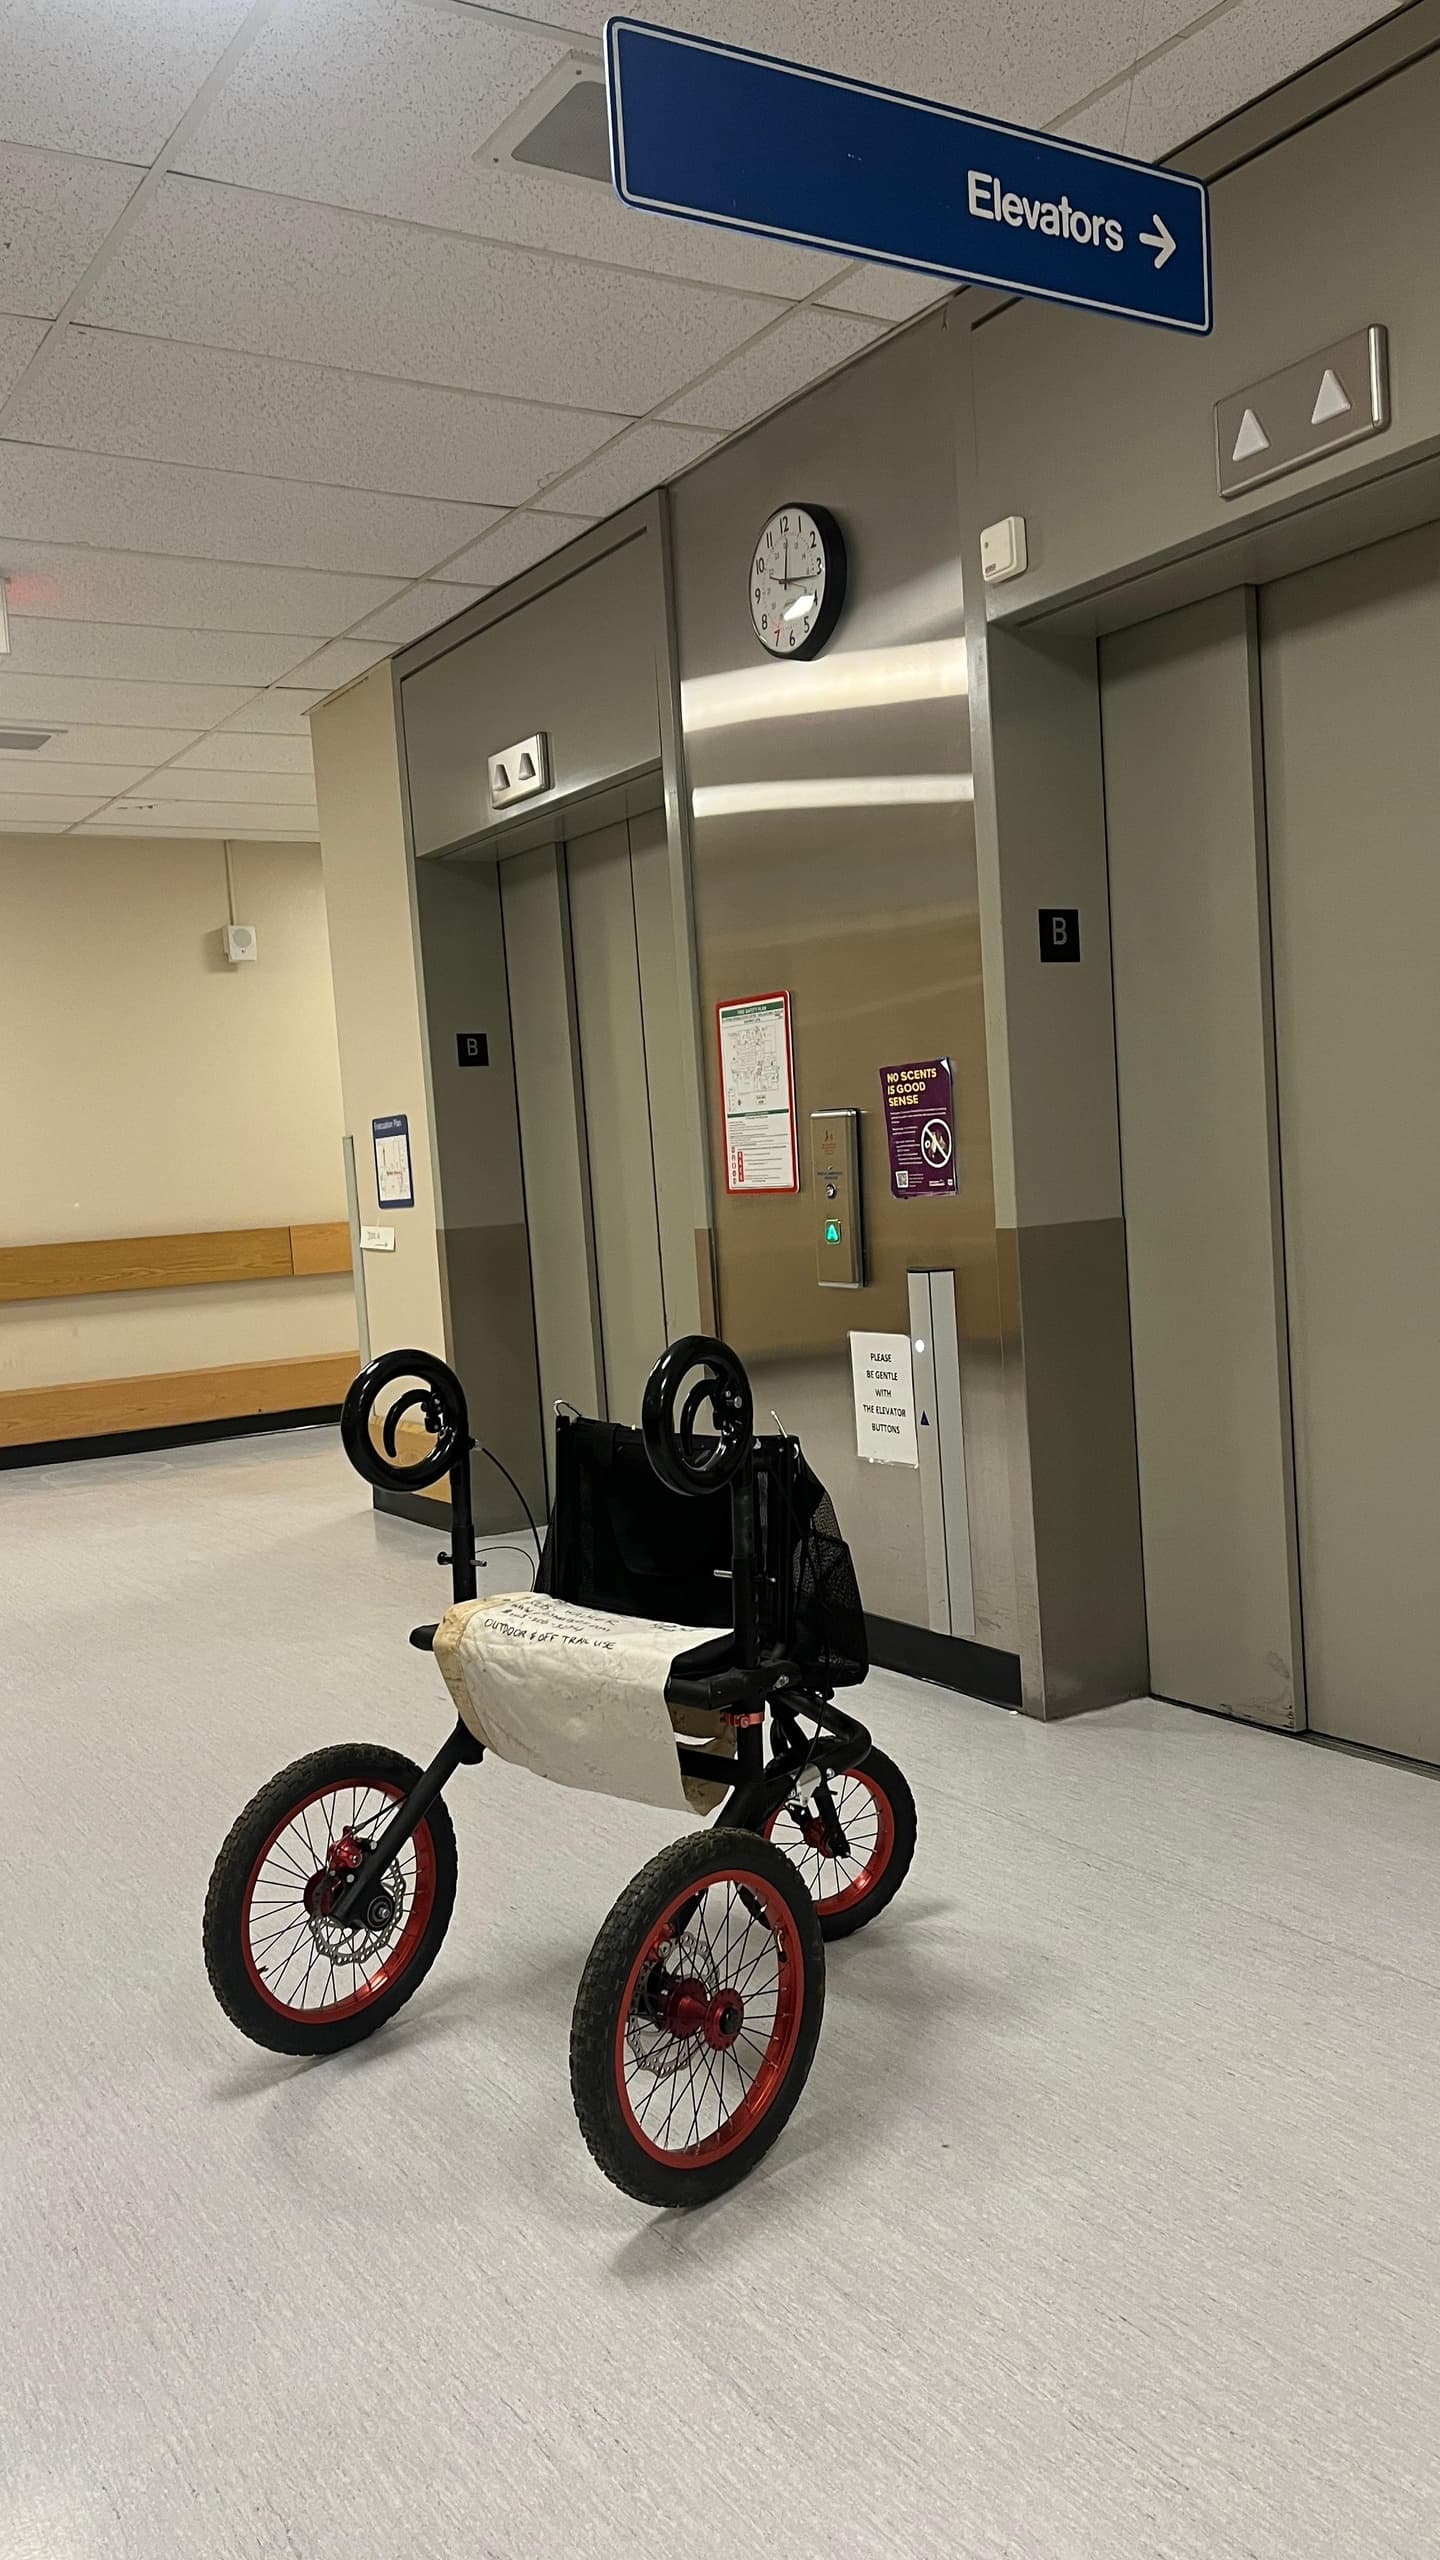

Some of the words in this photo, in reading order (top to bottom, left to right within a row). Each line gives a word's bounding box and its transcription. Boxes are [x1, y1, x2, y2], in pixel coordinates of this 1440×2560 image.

[967, 170, 1124, 253] Elevators
[779, 515, 789, 533] 12
[798, 515, 802, 533] 1
[766, 531, 773, 548] 11
[809, 531, 817, 549] 2
[755, 557, 765, 575] 10
[816, 557, 822, 575] 3
[754, 588, 761, 604] 9
[761, 613, 768, 630] 8
[804, 616, 810, 633] 5
[774, 629, 781, 647] 7
[789, 629, 796, 647] 6
[1052, 917, 1067, 945] B
[467, 1038, 478, 1056] B
[887, 1072, 899, 1083] NO
[900, 1068, 937, 1081] SCENTS
[887, 1085, 896, 1095] IS
[896, 1081, 926, 1094] GOOD
[888, 1094, 919, 1107] SENSE
[870, 1353, 892, 1363] PLEASE
[866, 1370, 874, 1379] BE
[875, 1370, 898, 1381] GENTLE
[875, 1389, 892, 1398] WITH
[862, 1404, 875, 1414] THE
[876, 1405, 906, 1417] ELEVATOR
[871, 1423, 900, 1434] BUTTONS
[484, 1618, 527, 1638] OUTDOOR
[538, 1632, 559, 1642] OFF
[563, 1635, 590, 1645] TRAIL
[594, 1641, 616, 1650] USE
